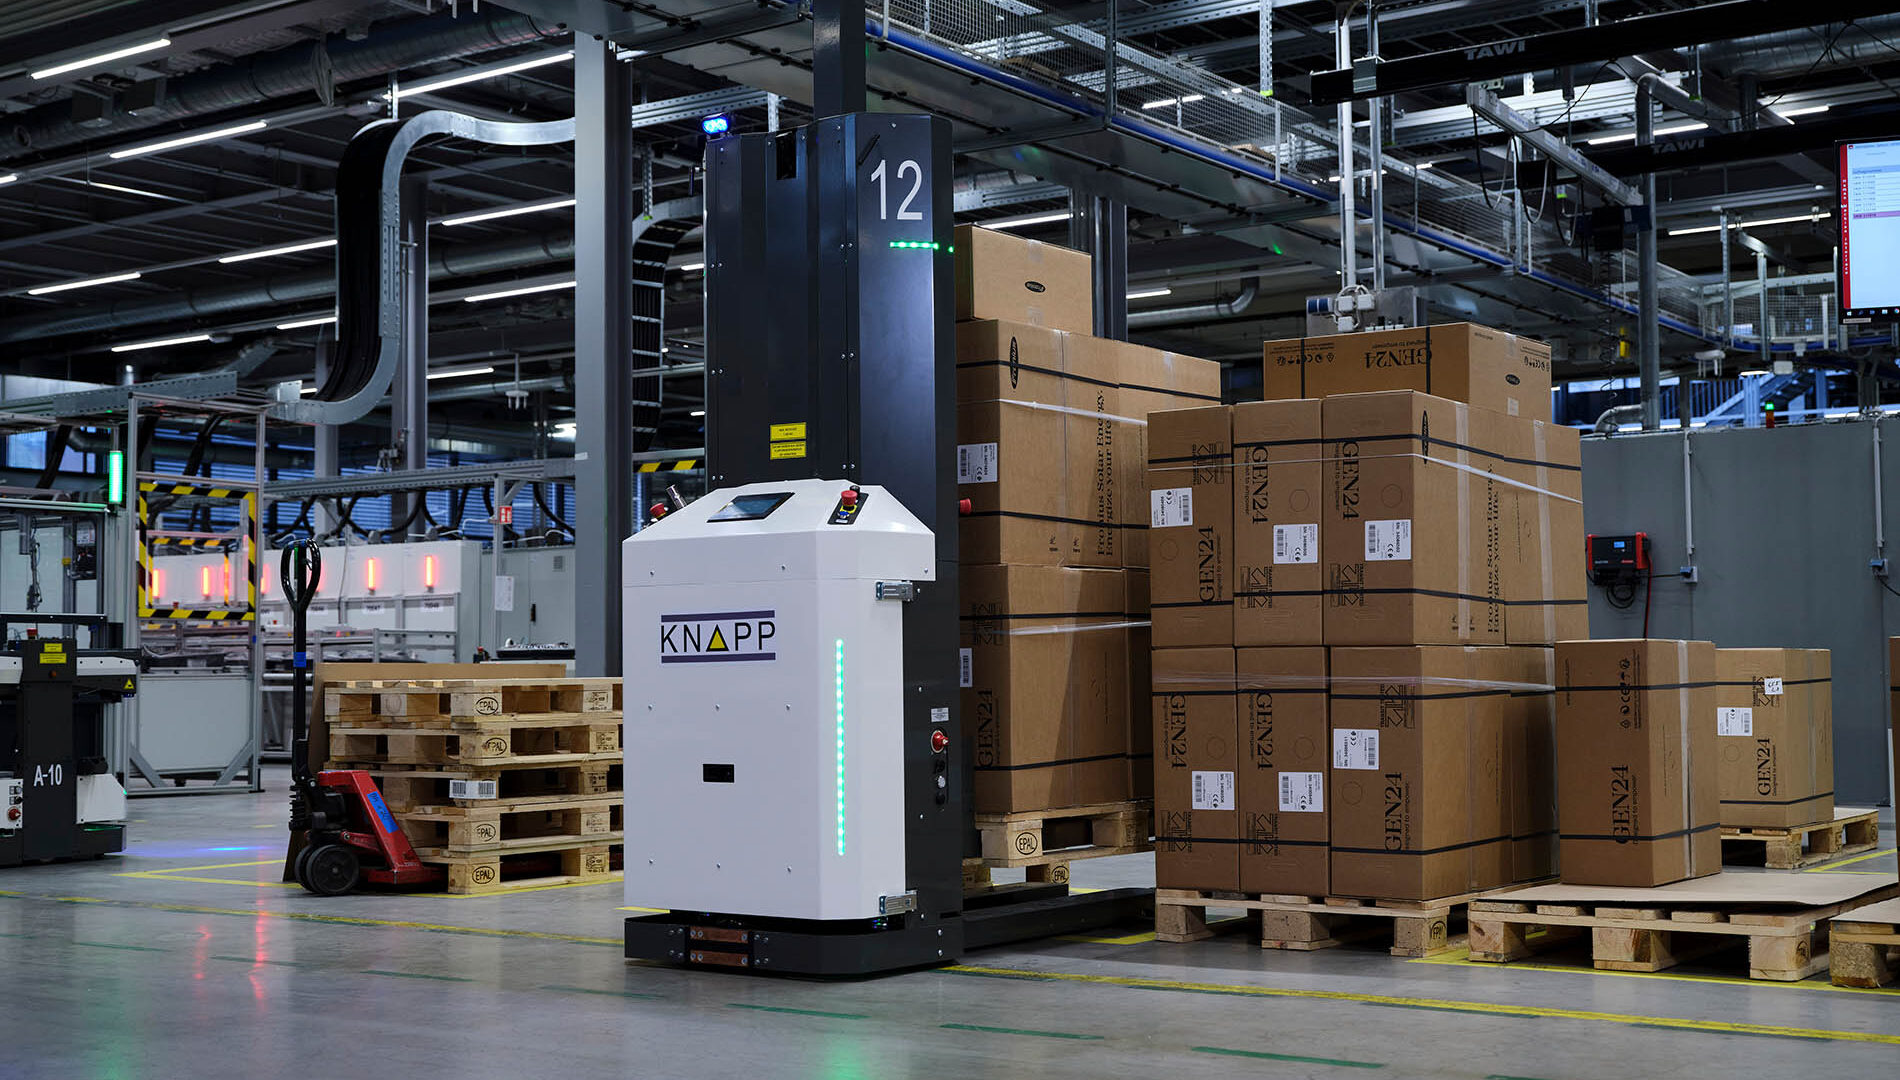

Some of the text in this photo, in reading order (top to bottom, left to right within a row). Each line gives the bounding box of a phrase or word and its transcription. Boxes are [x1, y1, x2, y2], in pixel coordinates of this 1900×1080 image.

[1463, 40, 1526, 61] TAWI
[1650, 138, 1705, 155] TAWI
[870, 159, 924, 221] 12
[1364, 347, 1432, 369] GEN24
[1252, 446, 1268, 524] GEN24
[1343, 441, 1360, 520] GEN24
[1199, 526, 1215, 602] GEN24
[978, 688, 993, 766] GEN24
[1171, 694, 1187, 768] GEN24
[1256, 693, 1273, 770] GEN24
[33, 764, 63, 786] A-10
[1757, 739, 1771, 796] GEN24
[1385, 772, 1401, 851] GEN24
[1611, 766, 1631, 845] GEN24
[475, 868, 491, 881] EPAL
[1019, 837, 1035, 850] EPAL
